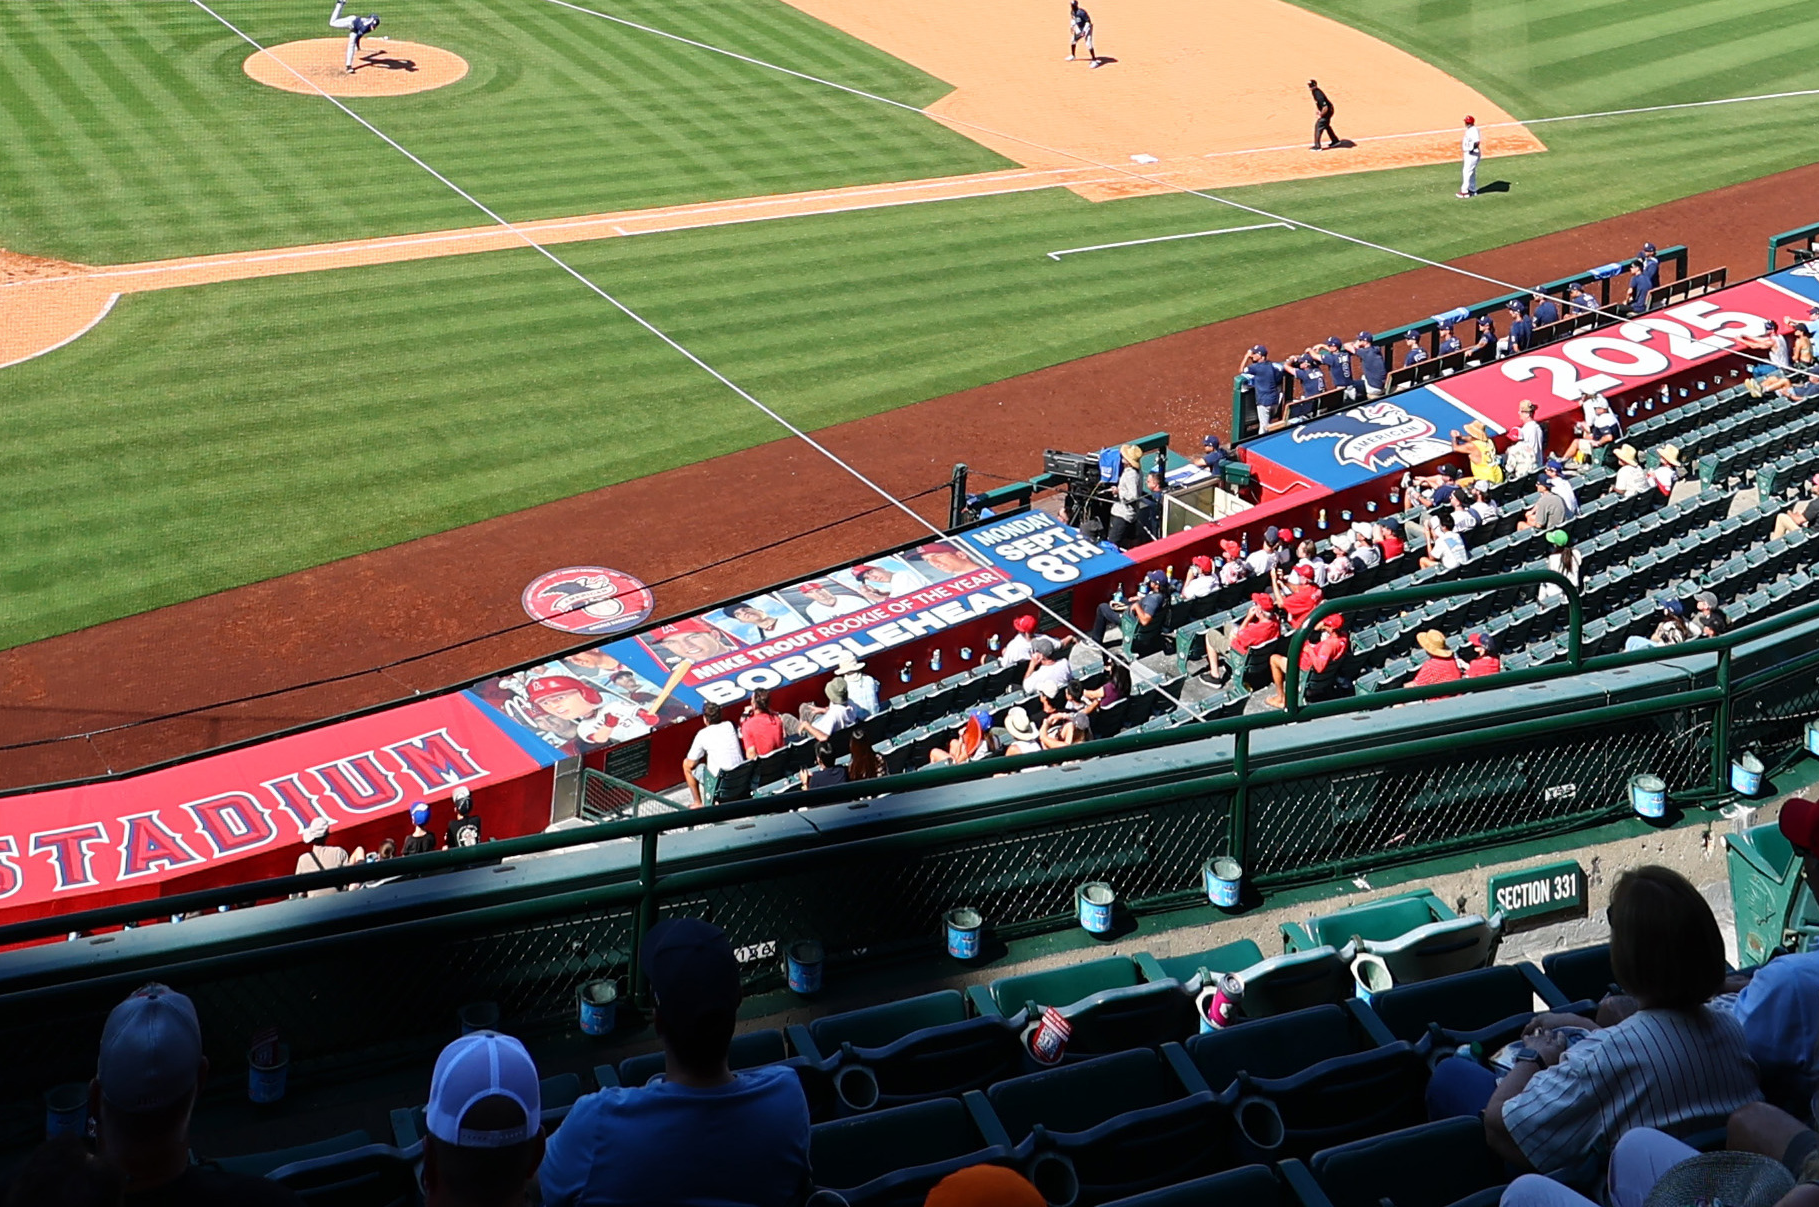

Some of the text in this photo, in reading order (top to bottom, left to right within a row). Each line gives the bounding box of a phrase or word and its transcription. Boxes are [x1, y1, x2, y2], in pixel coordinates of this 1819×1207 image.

[1500, 300, 1778, 402] 2025
[1352, 424, 1418, 453] AMERICAN
[972, 512, 1057, 547] MONDAY
[995, 526, 1084, 562] SEPT.
[1027, 539, 1105, 583] 8TH
[691, 570, 1000, 681] MIKE TROUT ROOKIE OF THE YEAR
[695, 581, 1034, 706] BOBBLEHEAD
[1496, 873, 1577, 911] SECTION 331
